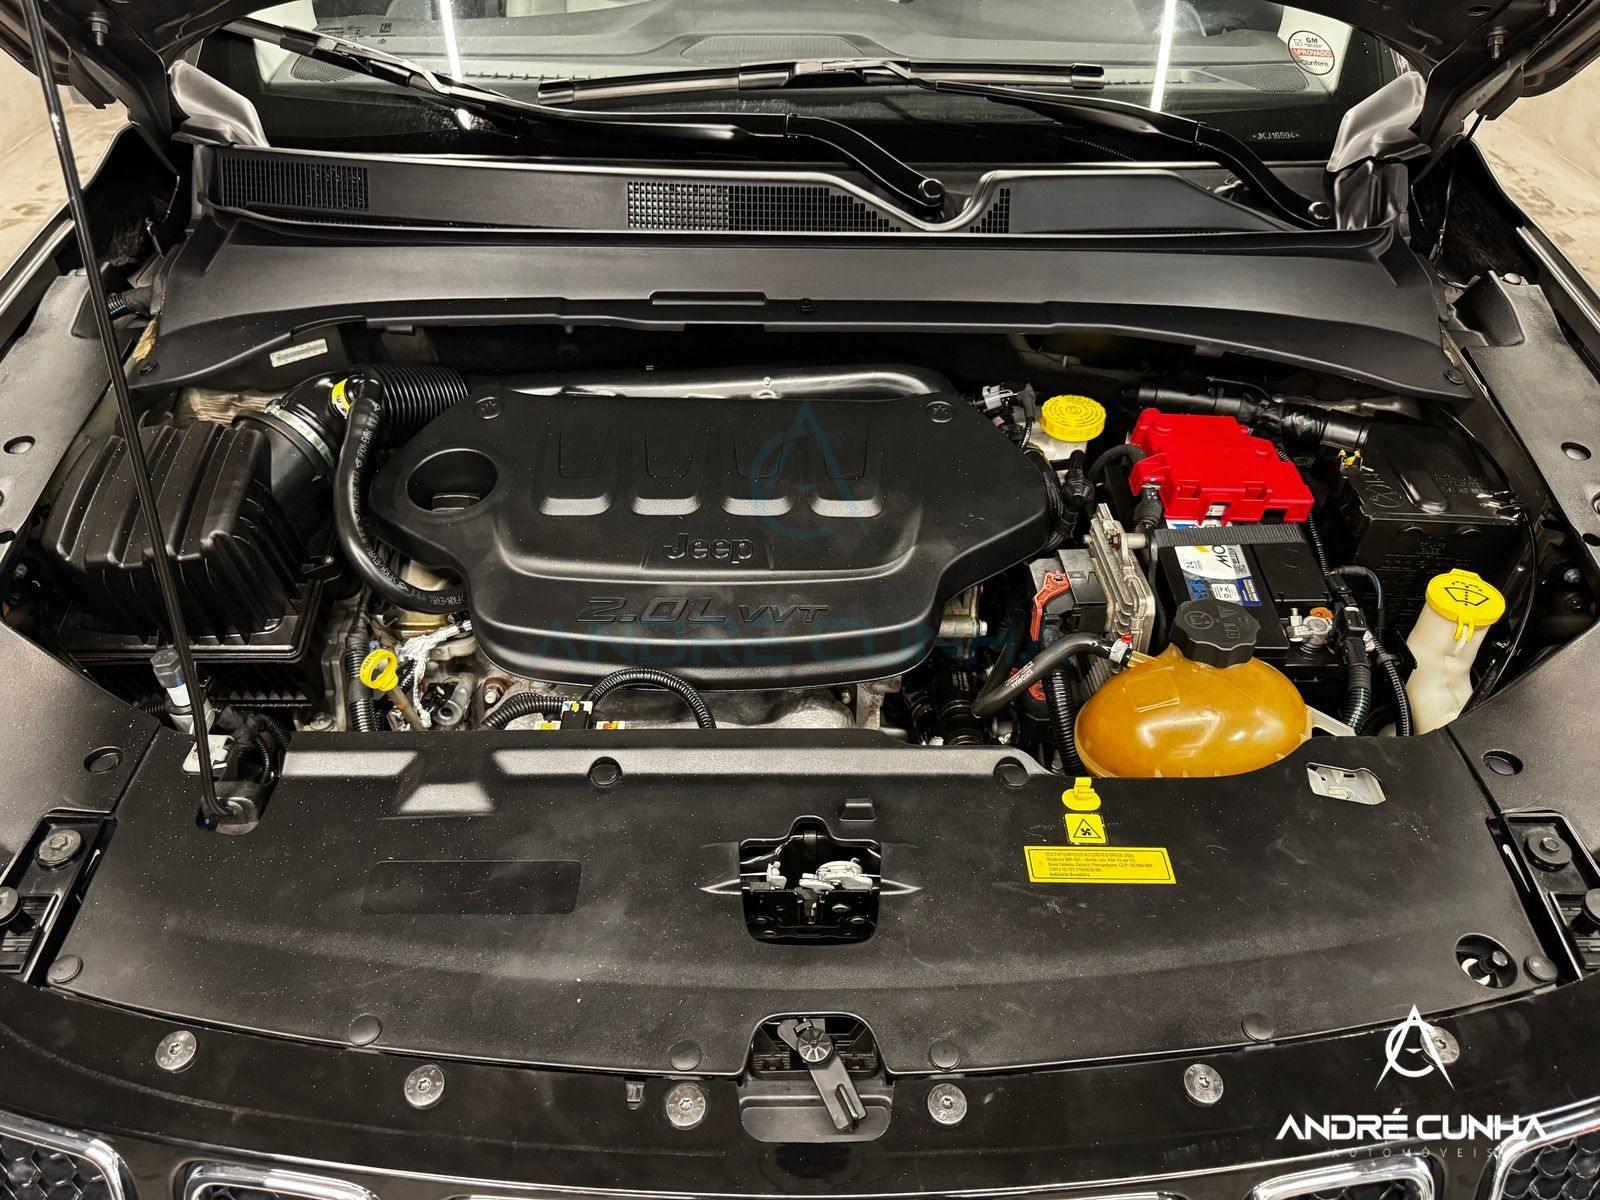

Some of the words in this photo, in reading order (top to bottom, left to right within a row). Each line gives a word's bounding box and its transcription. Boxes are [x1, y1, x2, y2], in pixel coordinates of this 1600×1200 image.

[663, 532, 755, 565] Jeep
[576, 596, 727, 623] 2.0L
[737, 604, 829, 623] VVT
